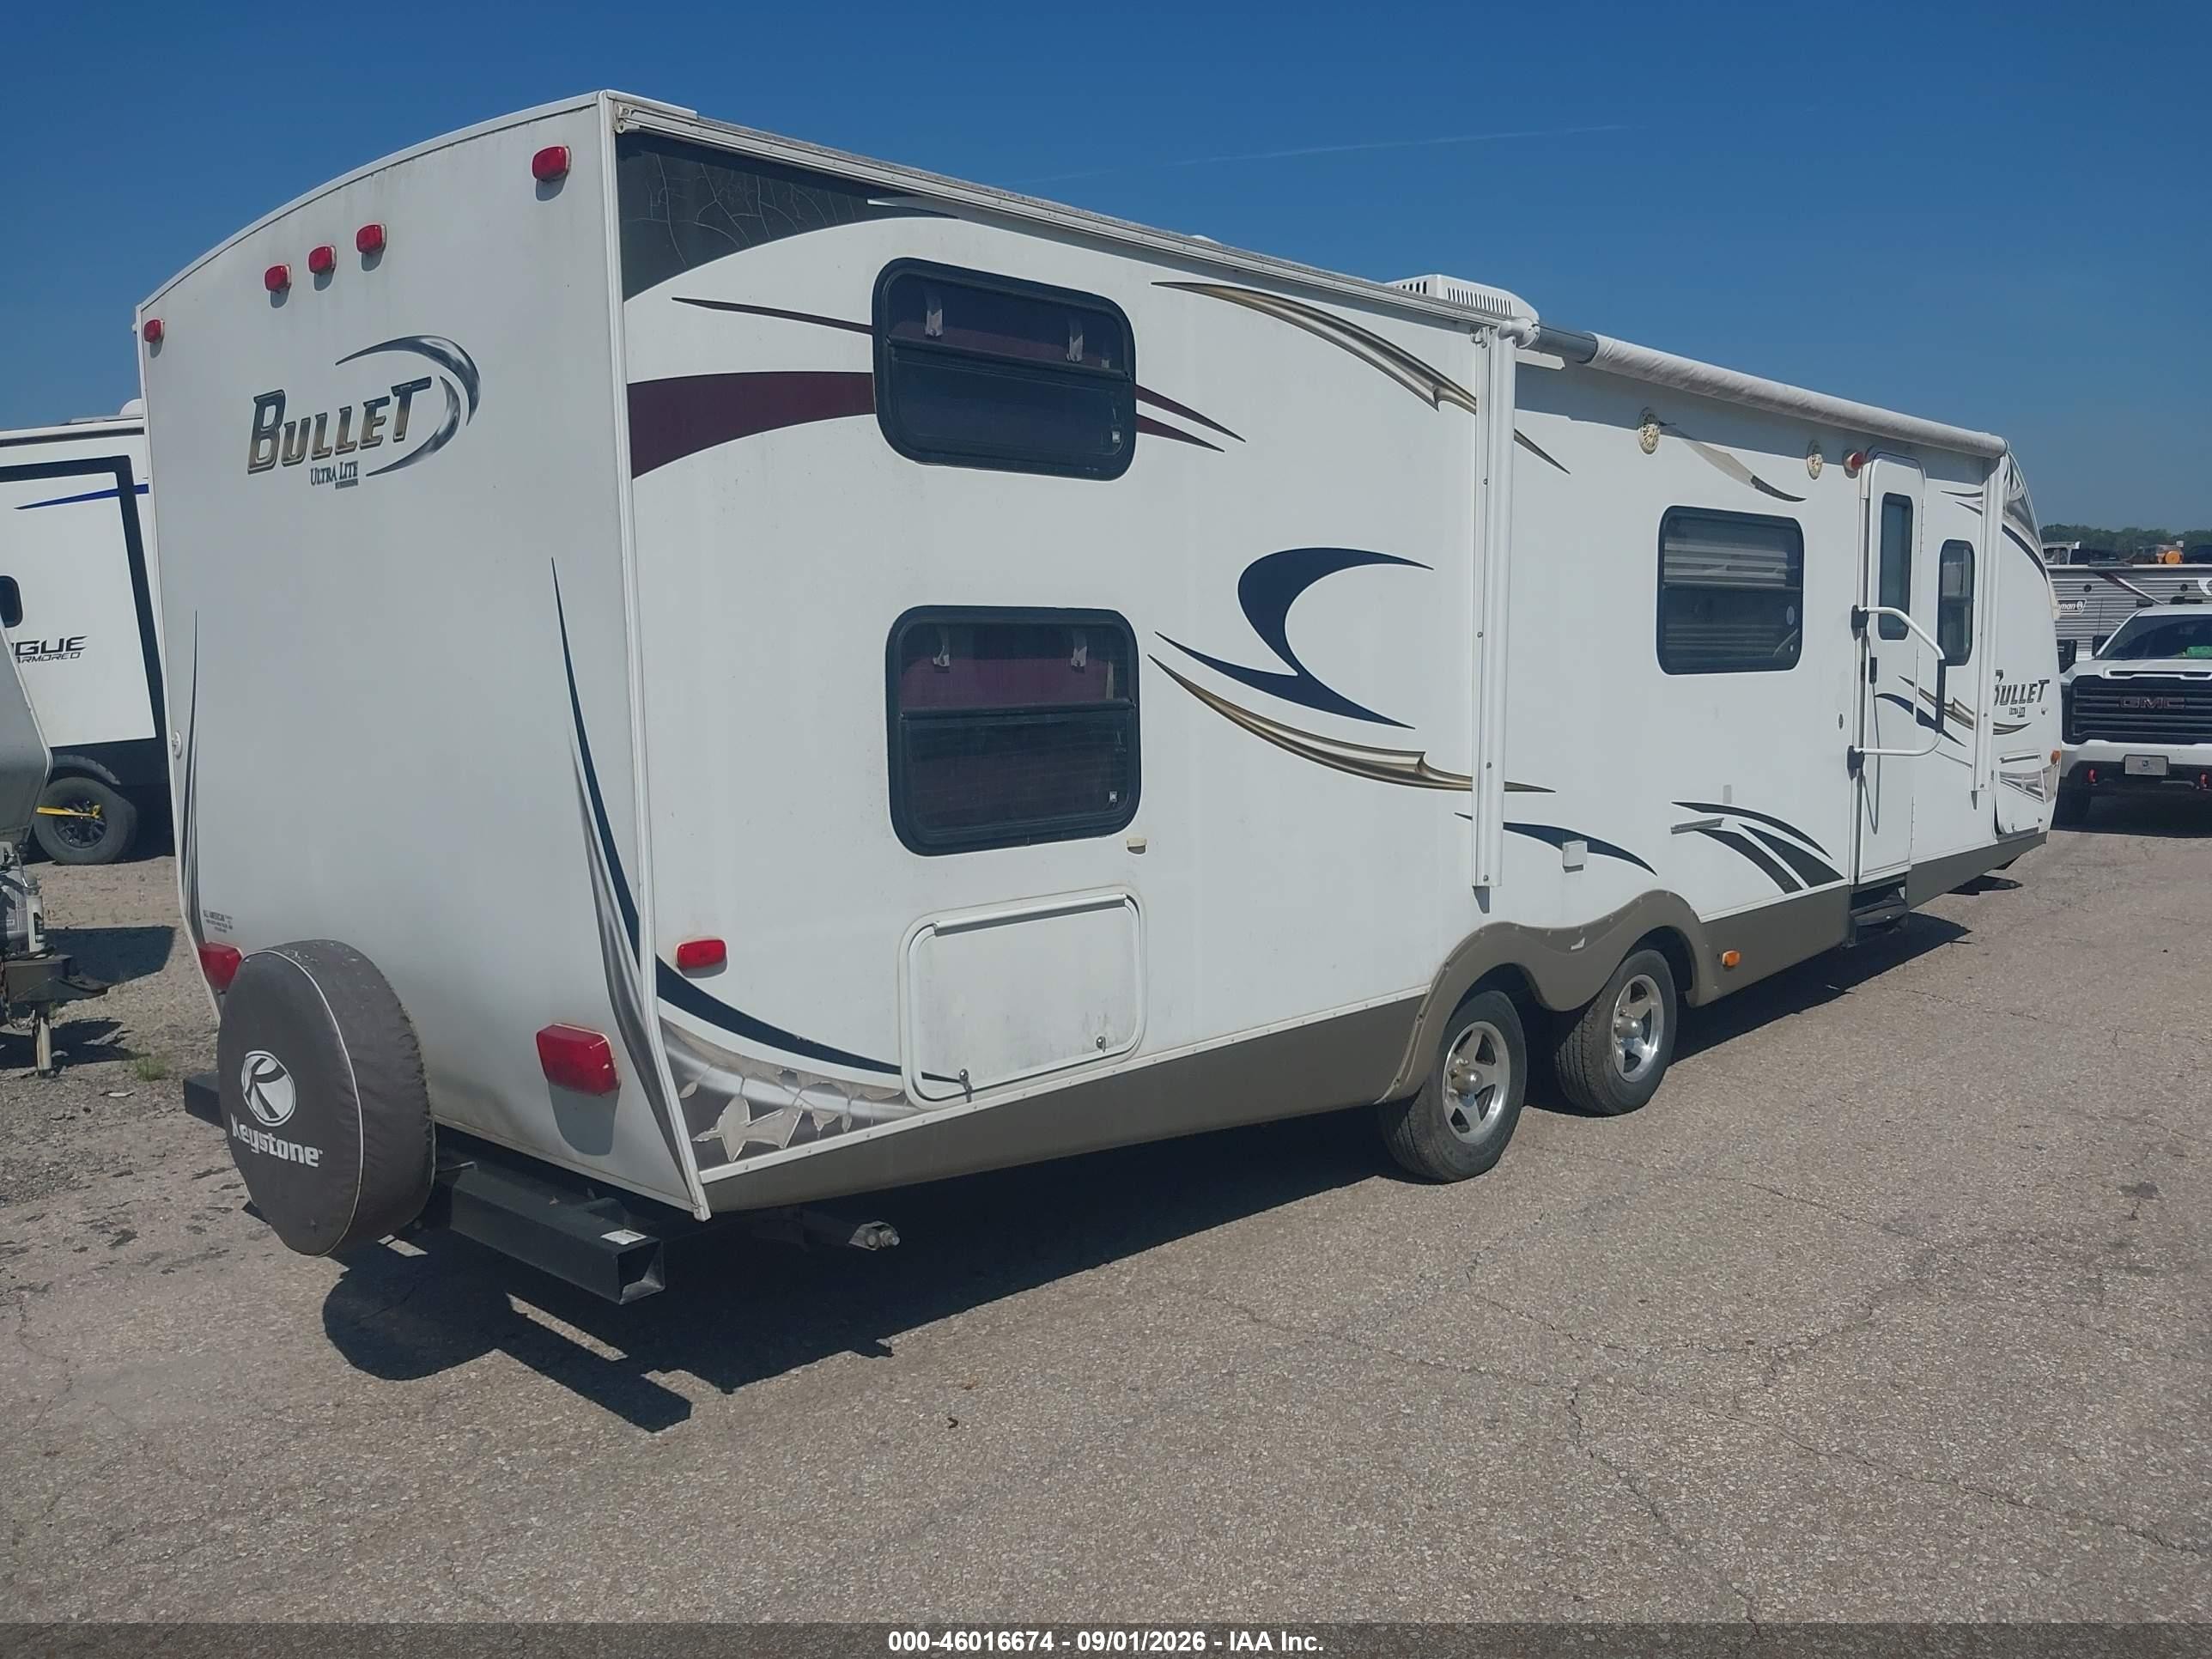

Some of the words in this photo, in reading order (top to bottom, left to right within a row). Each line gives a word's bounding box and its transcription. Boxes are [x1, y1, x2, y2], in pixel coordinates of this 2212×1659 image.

[247, 376, 432, 475] BULLET
[310, 465, 337, 486] ULTRA
[339, 460, 359, 480] LITE
[11, 635, 88, 656] GUE
[2119, 696, 2185, 708] GMC
[230, 1112, 320, 1168] Keystone
